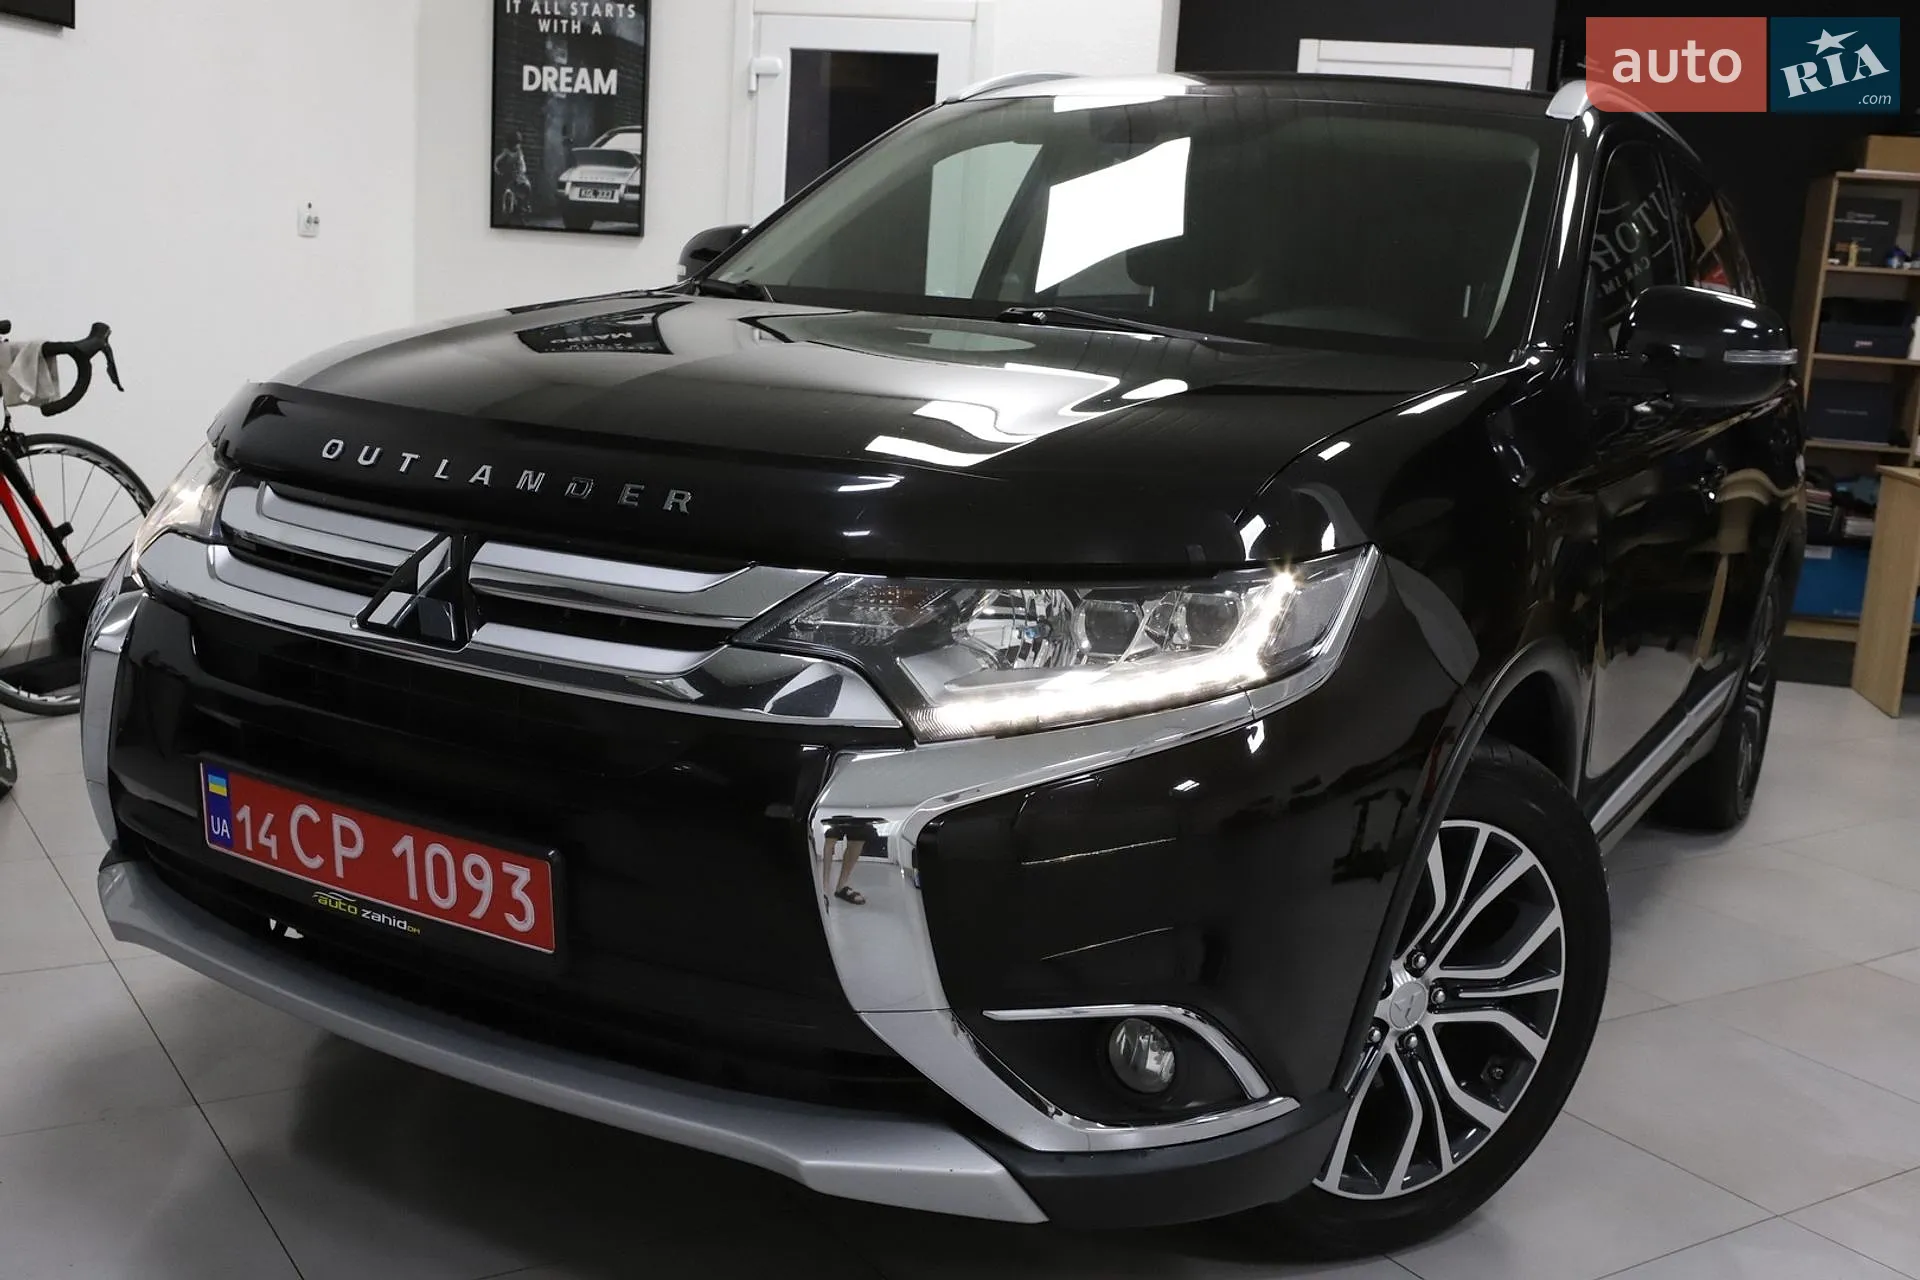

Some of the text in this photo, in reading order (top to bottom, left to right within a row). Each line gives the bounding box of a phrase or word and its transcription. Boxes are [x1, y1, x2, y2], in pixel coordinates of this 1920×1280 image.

[506, 0, 636, 18] IT ALL STARTS
[538, 18, 602, 35] WITH A
[522, 64, 618, 95] DREAM
[320, 437, 694, 515] OUTLANDER
[210, 817, 230, 840] UA
[391, 834, 536, 933] 1093
[317, 893, 359, 916] auto
